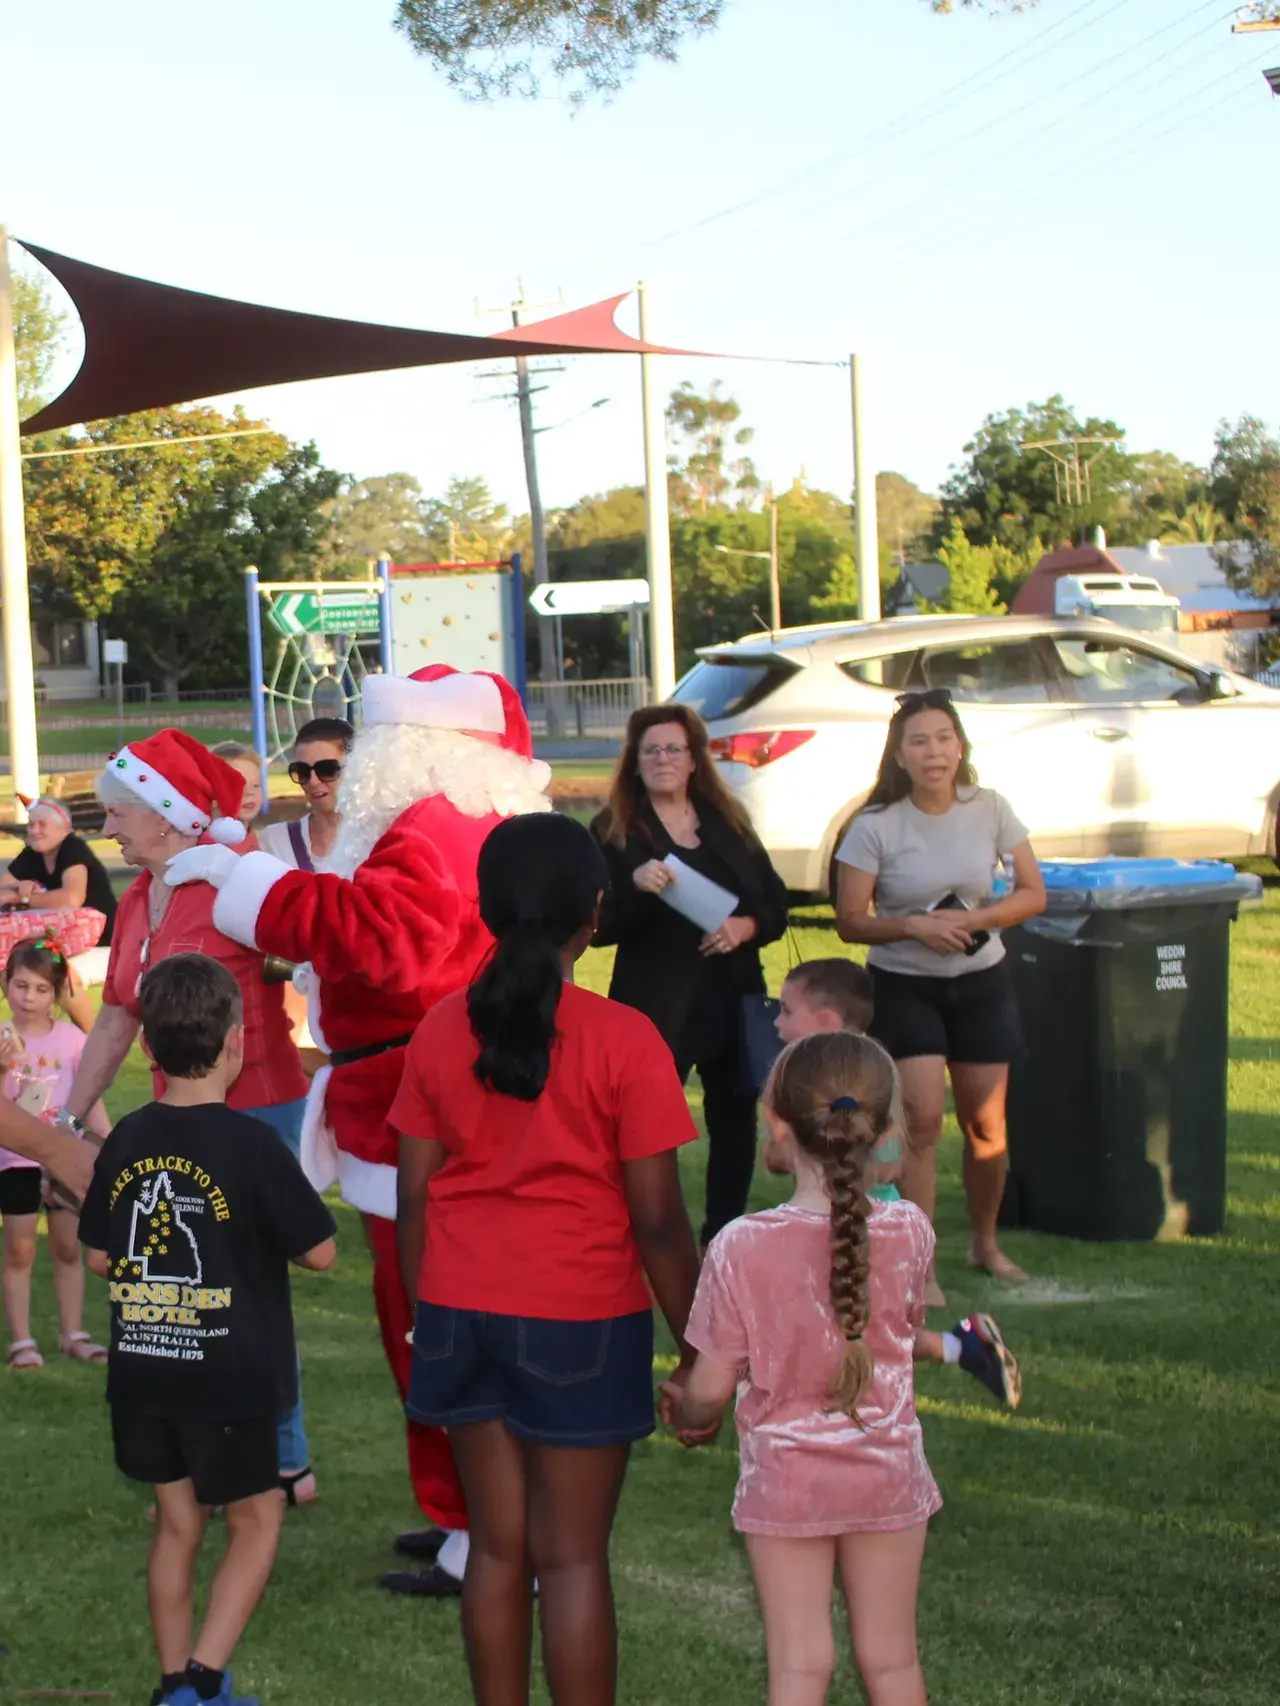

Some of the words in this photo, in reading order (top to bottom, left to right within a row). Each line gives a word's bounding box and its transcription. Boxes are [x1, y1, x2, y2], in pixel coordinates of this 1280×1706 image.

[1160, 960, 1182, 975] SHIRE
[1156, 975, 1188, 991] COUNCIL
[133, 1156, 192, 1175] TRACKS
[193, 1166, 210, 1188] TO
[207, 1185, 230, 1221] THE
[108, 1281, 180, 1306] IONS
[181, 1285, 232, 1310] DEN
[122, 1303, 201, 1326] HOTEL
[140, 1324, 172, 1334] NORTH
[173, 1327, 229, 1338] QUEENSLAND
[122, 1333, 199, 1347] AUSTRALIA
[118, 1341, 179, 1359] Established
[181, 1348, 204, 1360] 1875
